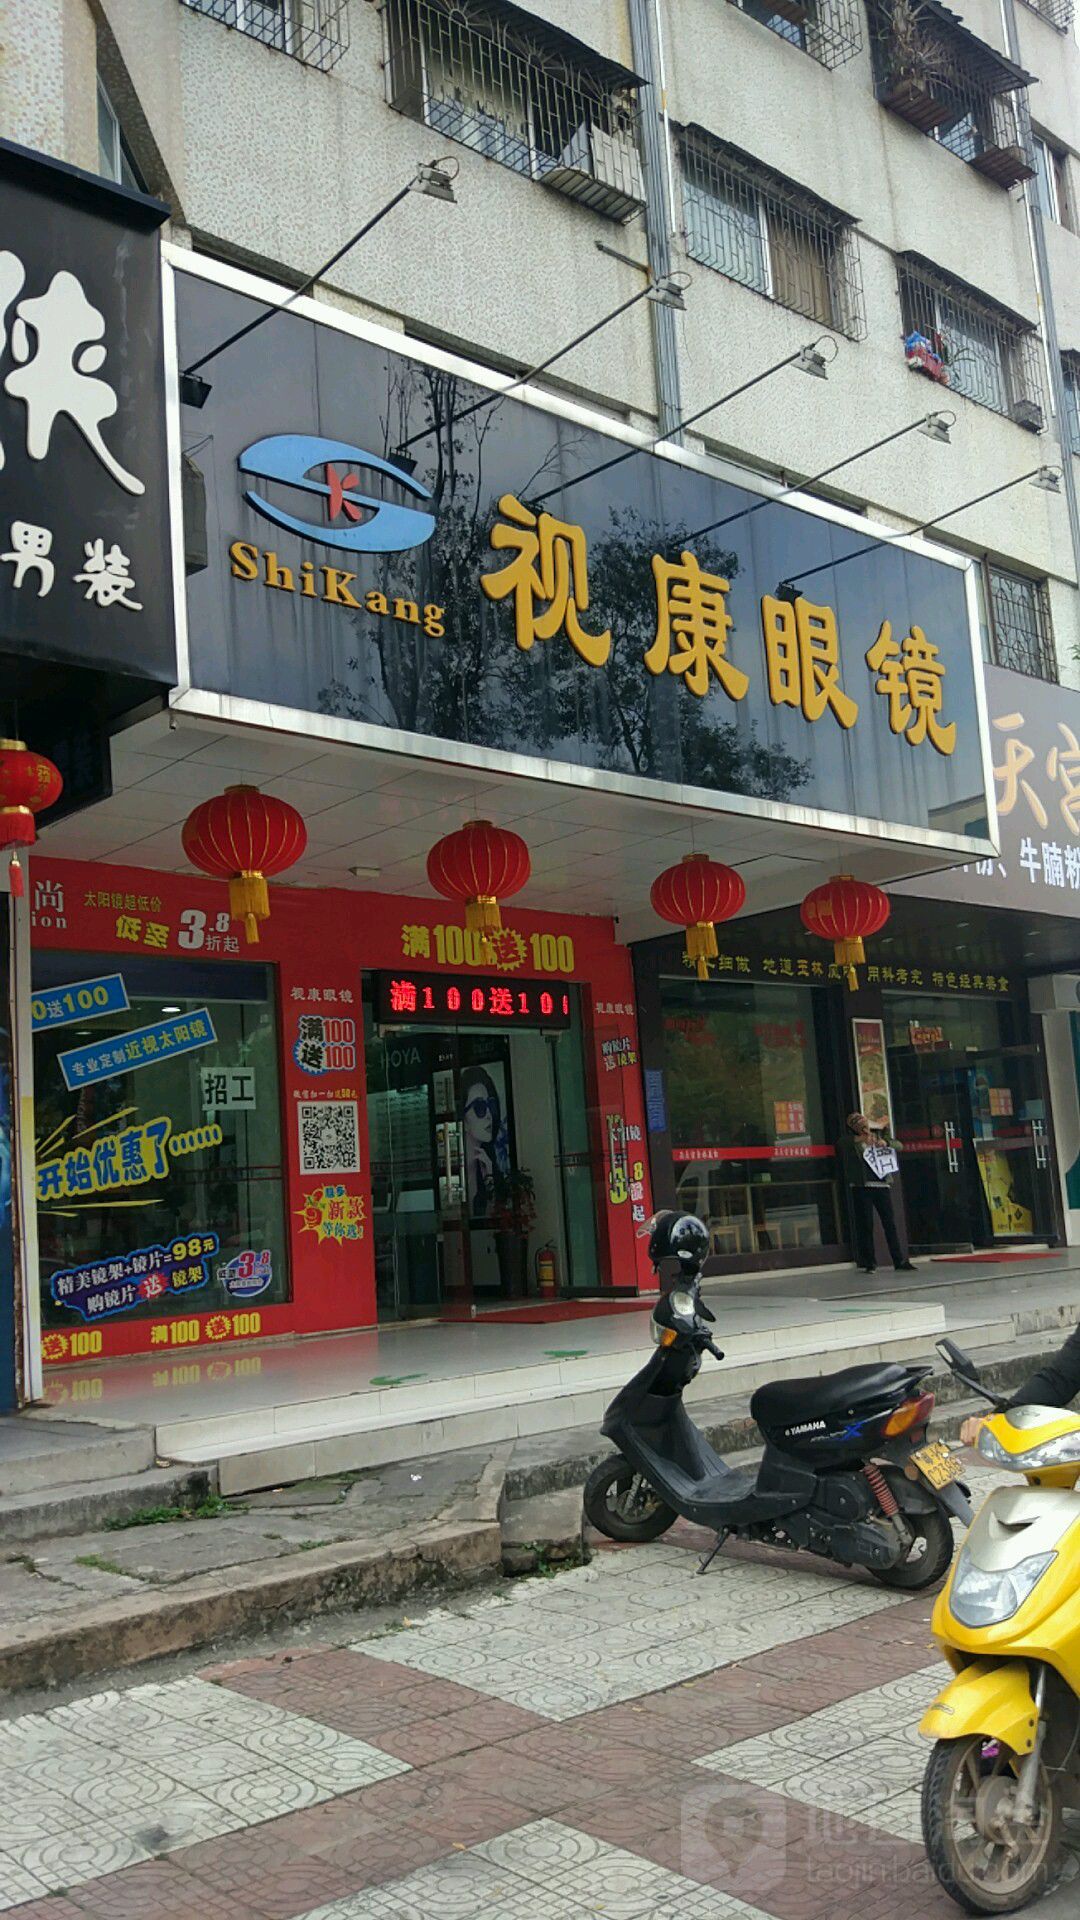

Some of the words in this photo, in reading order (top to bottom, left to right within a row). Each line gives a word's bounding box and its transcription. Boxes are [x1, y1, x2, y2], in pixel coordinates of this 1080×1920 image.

[0, 519, 144, 612] 男装
[229, 540, 446, 638] ShiKang
[480, 494, 957, 758] 视康眼镜
[35, 880, 64, 914] 尚
[84, 890, 162, 913] 太阳镜超低价
[116, 914, 170, 949] 低至
[205, 934, 240, 953] 折起
[400, 924, 575, 974] 满100送100
[71, 1018, 208, 1077] 专业定制近视太阳镜
[204, 1072, 254, 1105] 招工
[791, 1420, 826, 1436] YAMAHA
